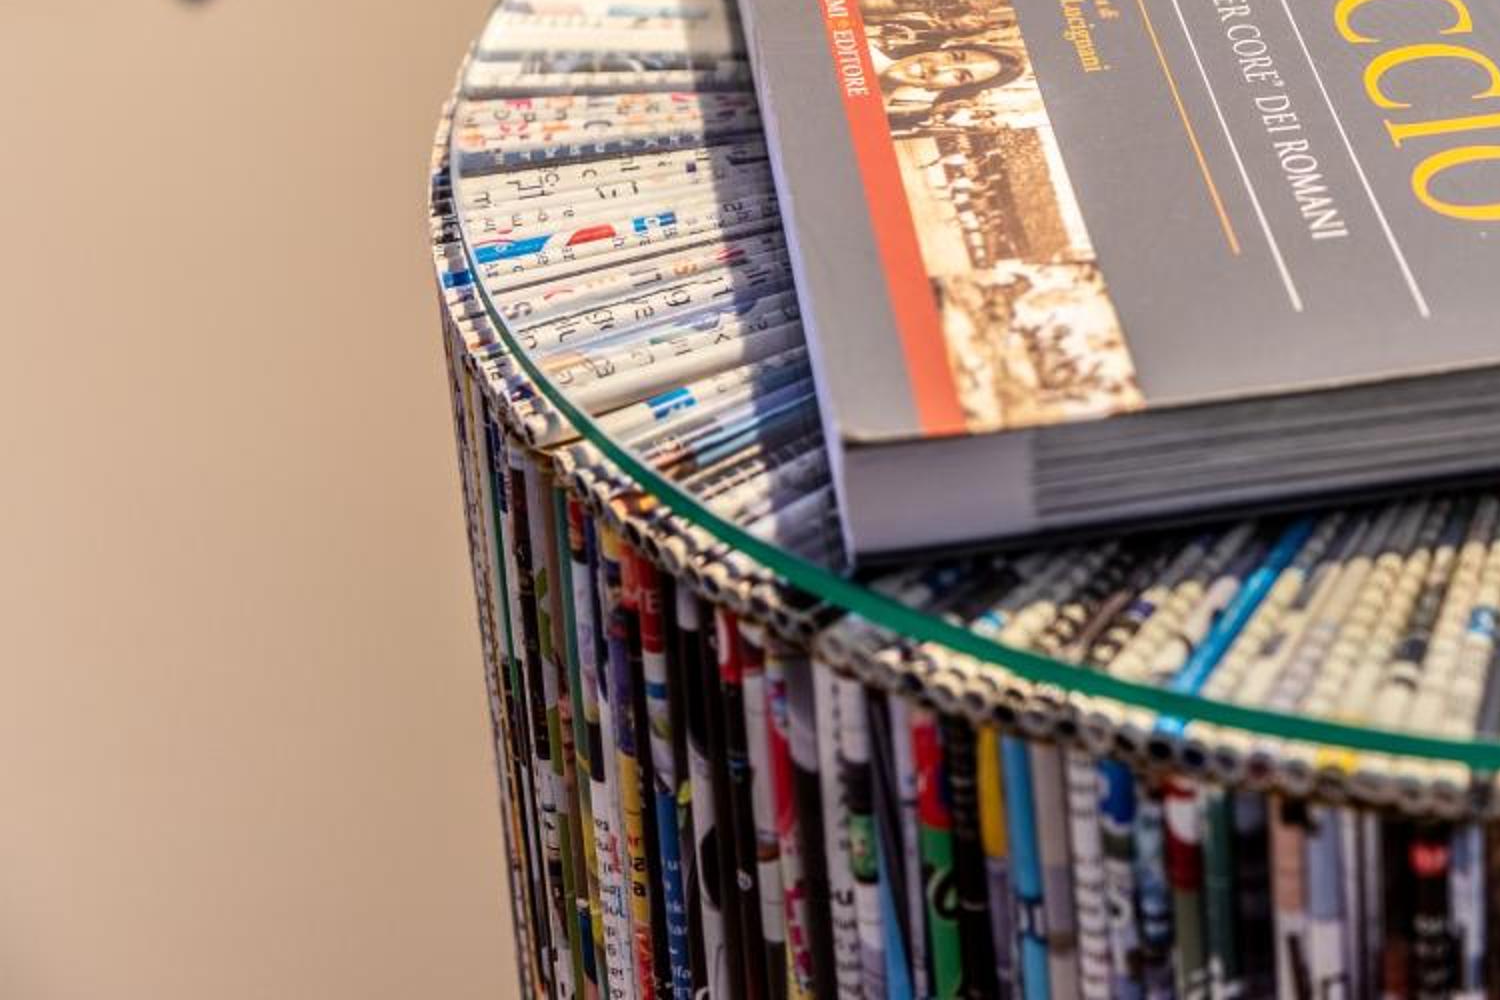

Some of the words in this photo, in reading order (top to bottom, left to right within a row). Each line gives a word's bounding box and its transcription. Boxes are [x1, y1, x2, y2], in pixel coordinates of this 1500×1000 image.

[832, 27, 869, 98] EDITORE
[1255, 94, 1301, 134] DEI
[1274, 138, 1348, 240] ROMANI
